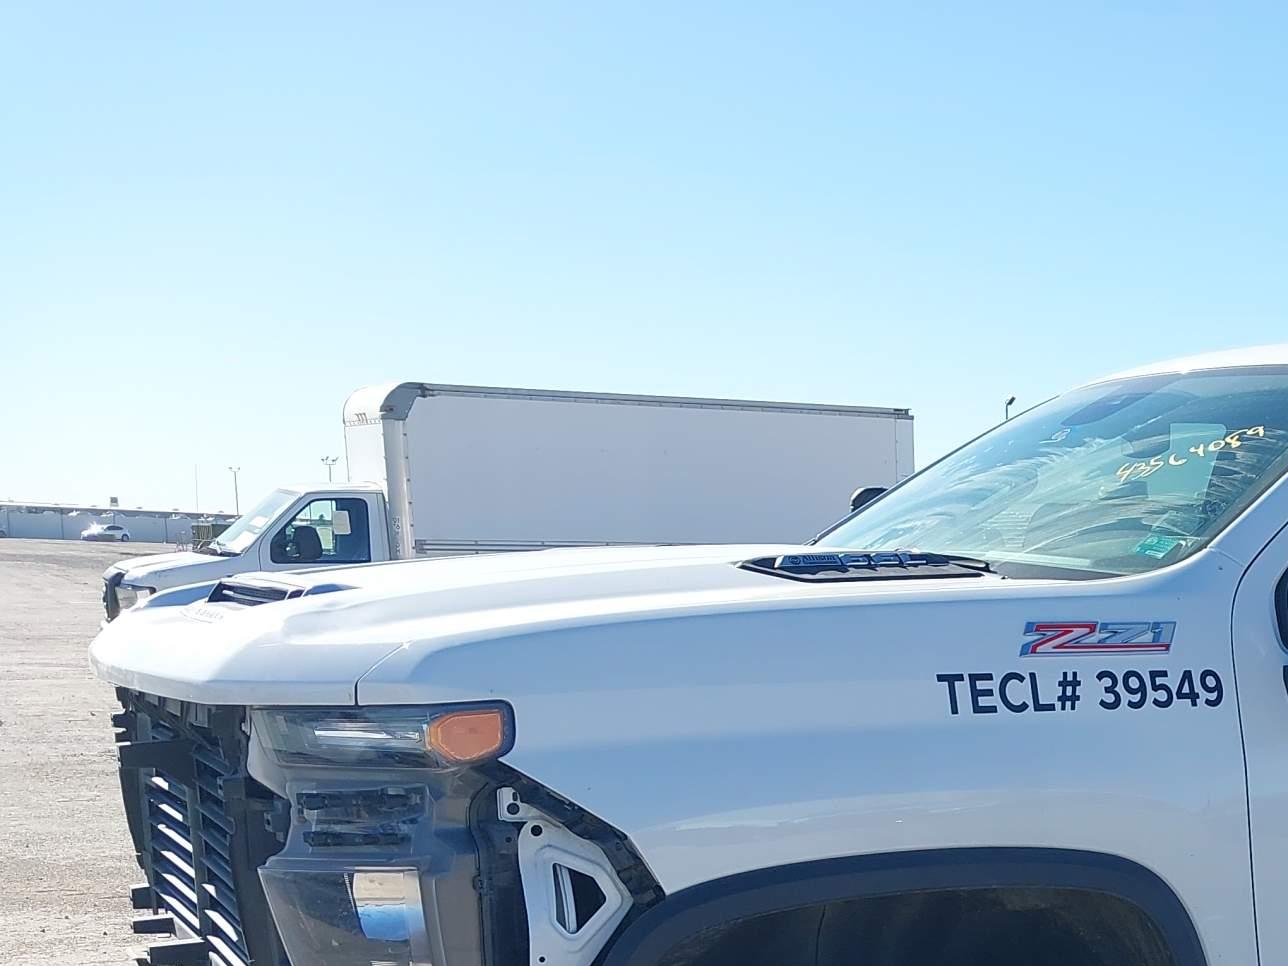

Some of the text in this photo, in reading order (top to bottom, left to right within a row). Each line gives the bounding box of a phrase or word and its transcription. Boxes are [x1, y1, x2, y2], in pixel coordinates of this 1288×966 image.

[1019, 621, 1177, 656] Z71
[936, 669, 1224, 715] TECL# 39549
